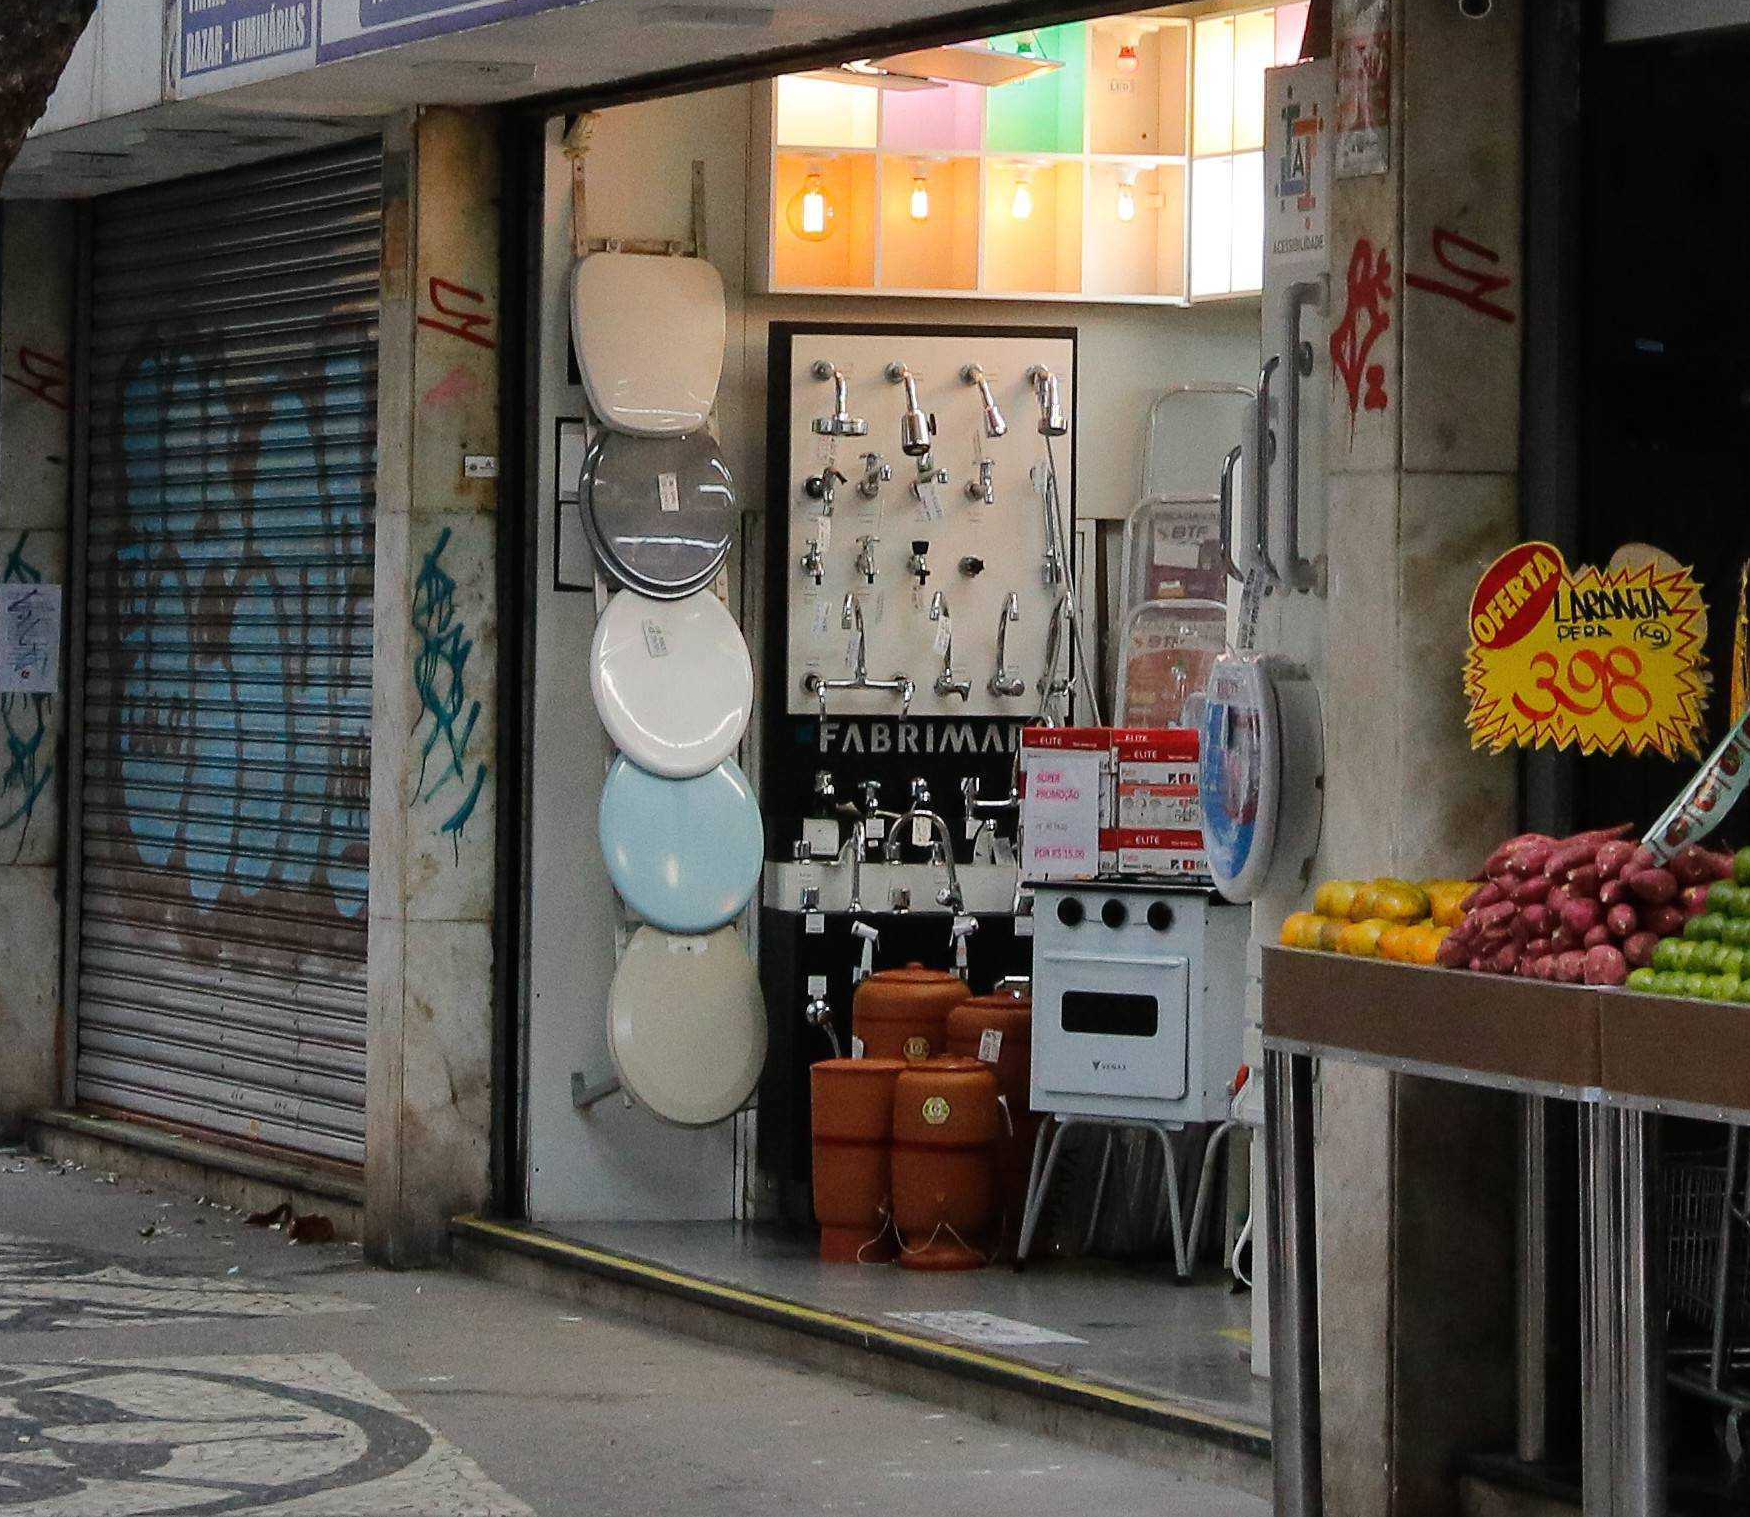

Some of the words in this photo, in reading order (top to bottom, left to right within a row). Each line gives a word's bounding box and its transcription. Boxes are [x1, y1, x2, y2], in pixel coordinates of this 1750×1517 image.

[186, 25, 223, 73] BAZAR
[232, 4, 305, 62] LUMINÁRIAS
[1473, 551, 1558, 643] OFERTA
[1553, 586, 1673, 625] LARANJA
[1556, 624, 1613, 643] PERA
[1040, 735, 1063, 746] ELITE
[1134, 750, 1158, 760] ELITE
[1135, 835, 1161, 846] ELITE
